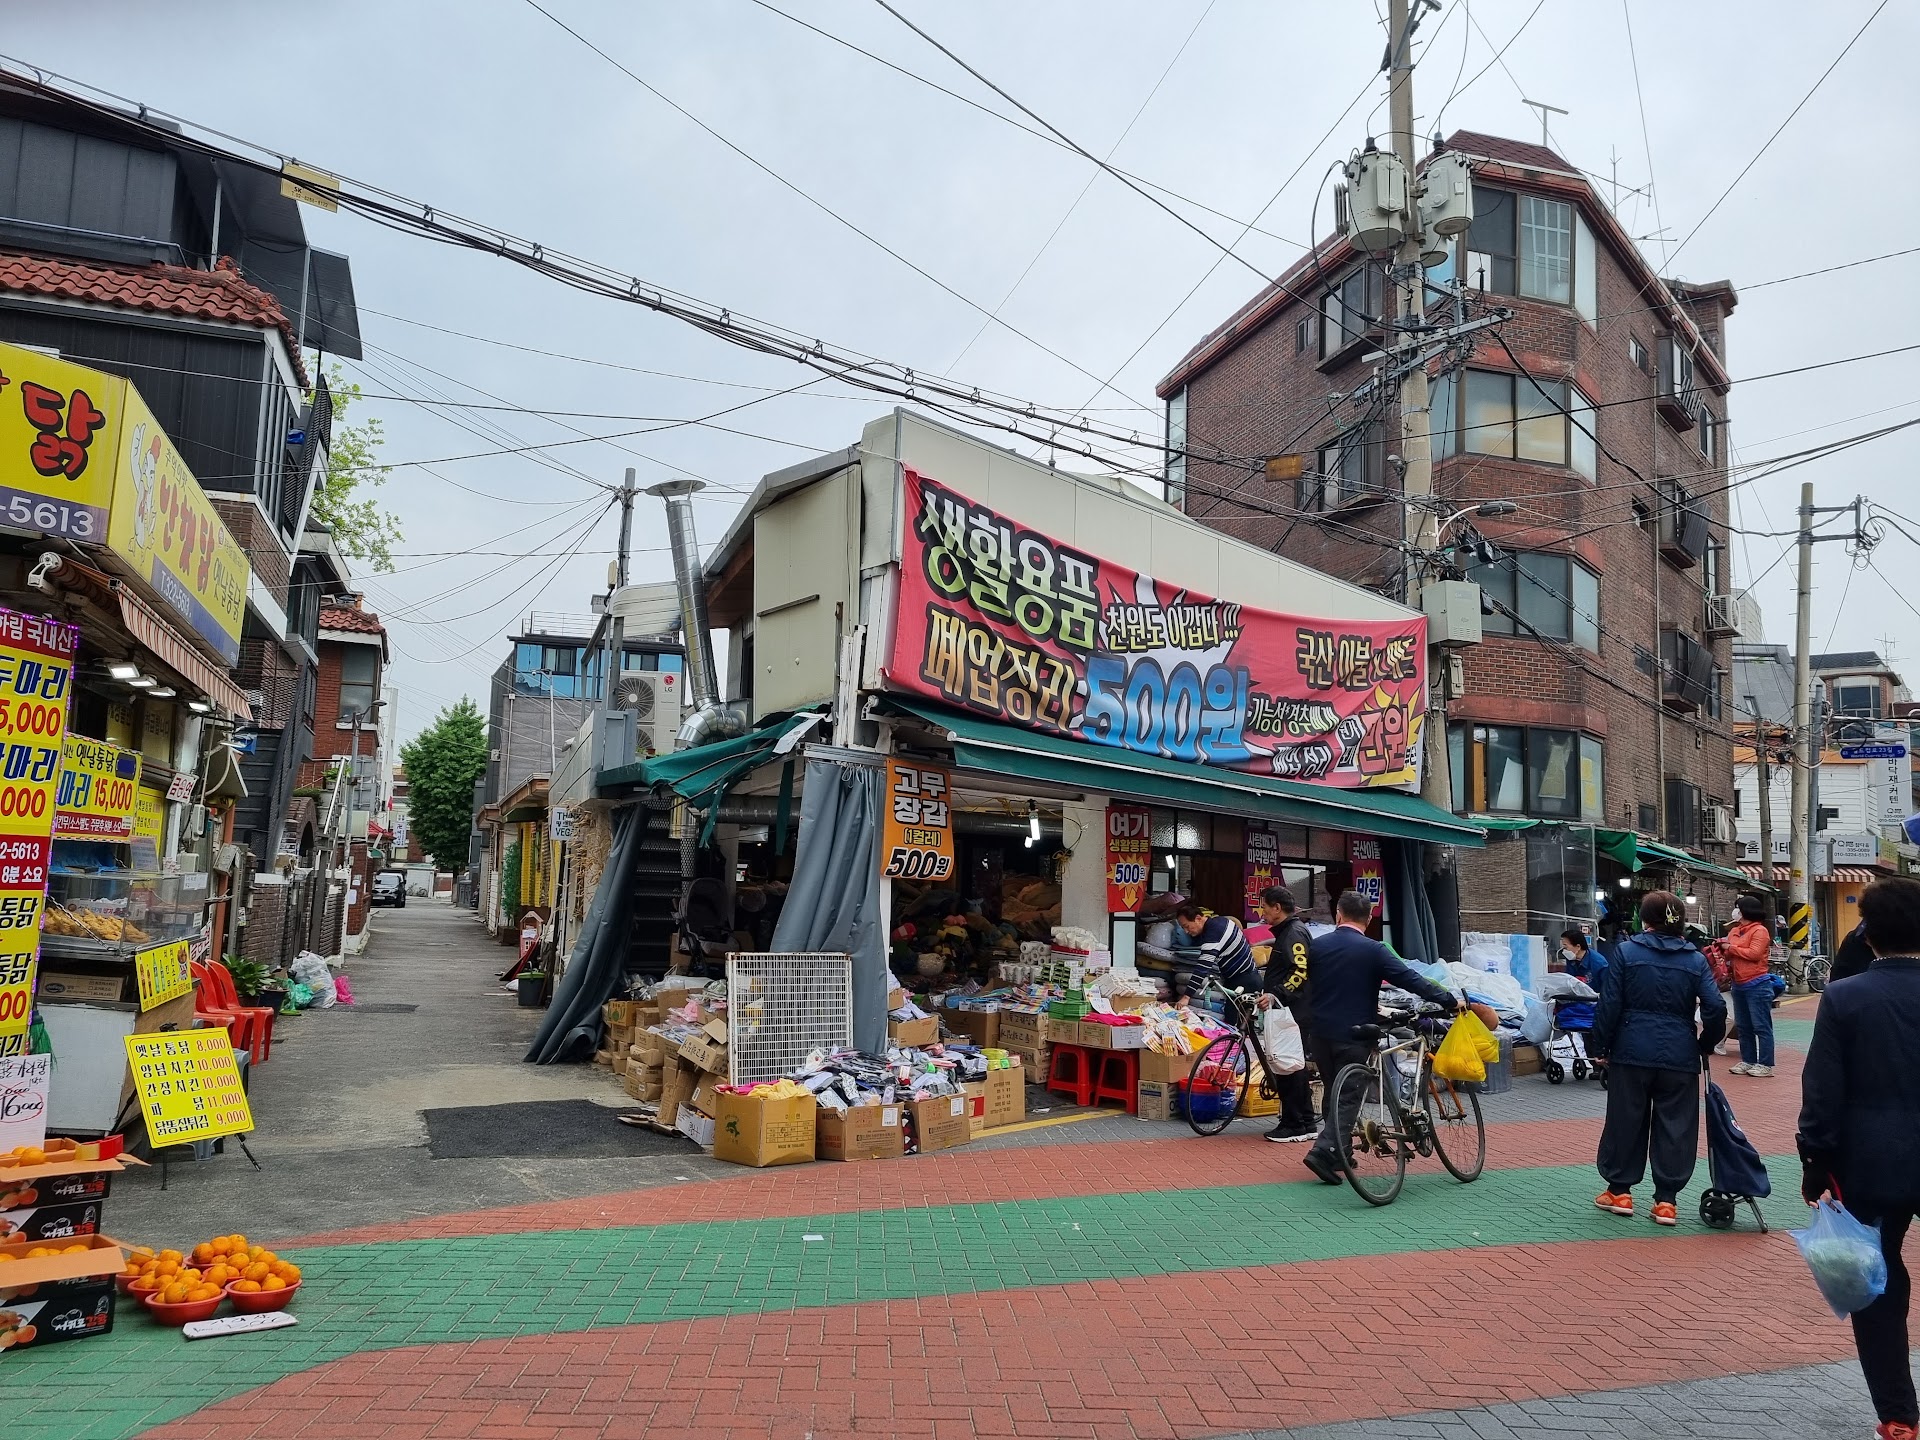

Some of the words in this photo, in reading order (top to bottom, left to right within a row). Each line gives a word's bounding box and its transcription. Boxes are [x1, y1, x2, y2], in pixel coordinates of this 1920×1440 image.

[0, 369, 105, 481] 닭
[918, 487, 1099, 651] 생활용품
[27, 619, 73, 653] 국내산
[1106, 606, 1166, 650] 천원도
[1298, 633, 1335, 686] 국산
[1339, 639, 1371, 687] 이불
[923, 608, 1076, 732] 폐업정리
[1081, 656, 1250, 763] 500원
[1361, 706, 1409, 774] 만원
[0, 742, 59, 783] 마리
[76, 743, 115, 773] 옛날통닭
[94, 777, 133, 813] 15,000
[893, 765, 947, 799] 고무
[893, 796, 948, 828] 장갑
[1109, 811, 1149, 838] 여기
[903, 827, 942, 847] (1켤레)
[1109, 838, 1149, 853] 생활용품
[1352, 839, 1382, 861] 국산이불
[884, 846, 952, 879] 500원
[1247, 848, 1278, 866] 마약방석
[21, 866, 43, 884] 소요
[1114, 862, 1146, 885] 500원
[196, 1037, 226, 1053] 8,000
[197, 1056, 232, 1072] 10,000
[202, 1074, 237, 1090] 10,000
[206, 1092, 242, 1109] 11,000
[154, 1114, 210, 1136] 닭똥집튀김
[216, 1109, 246, 1126] 9,000
